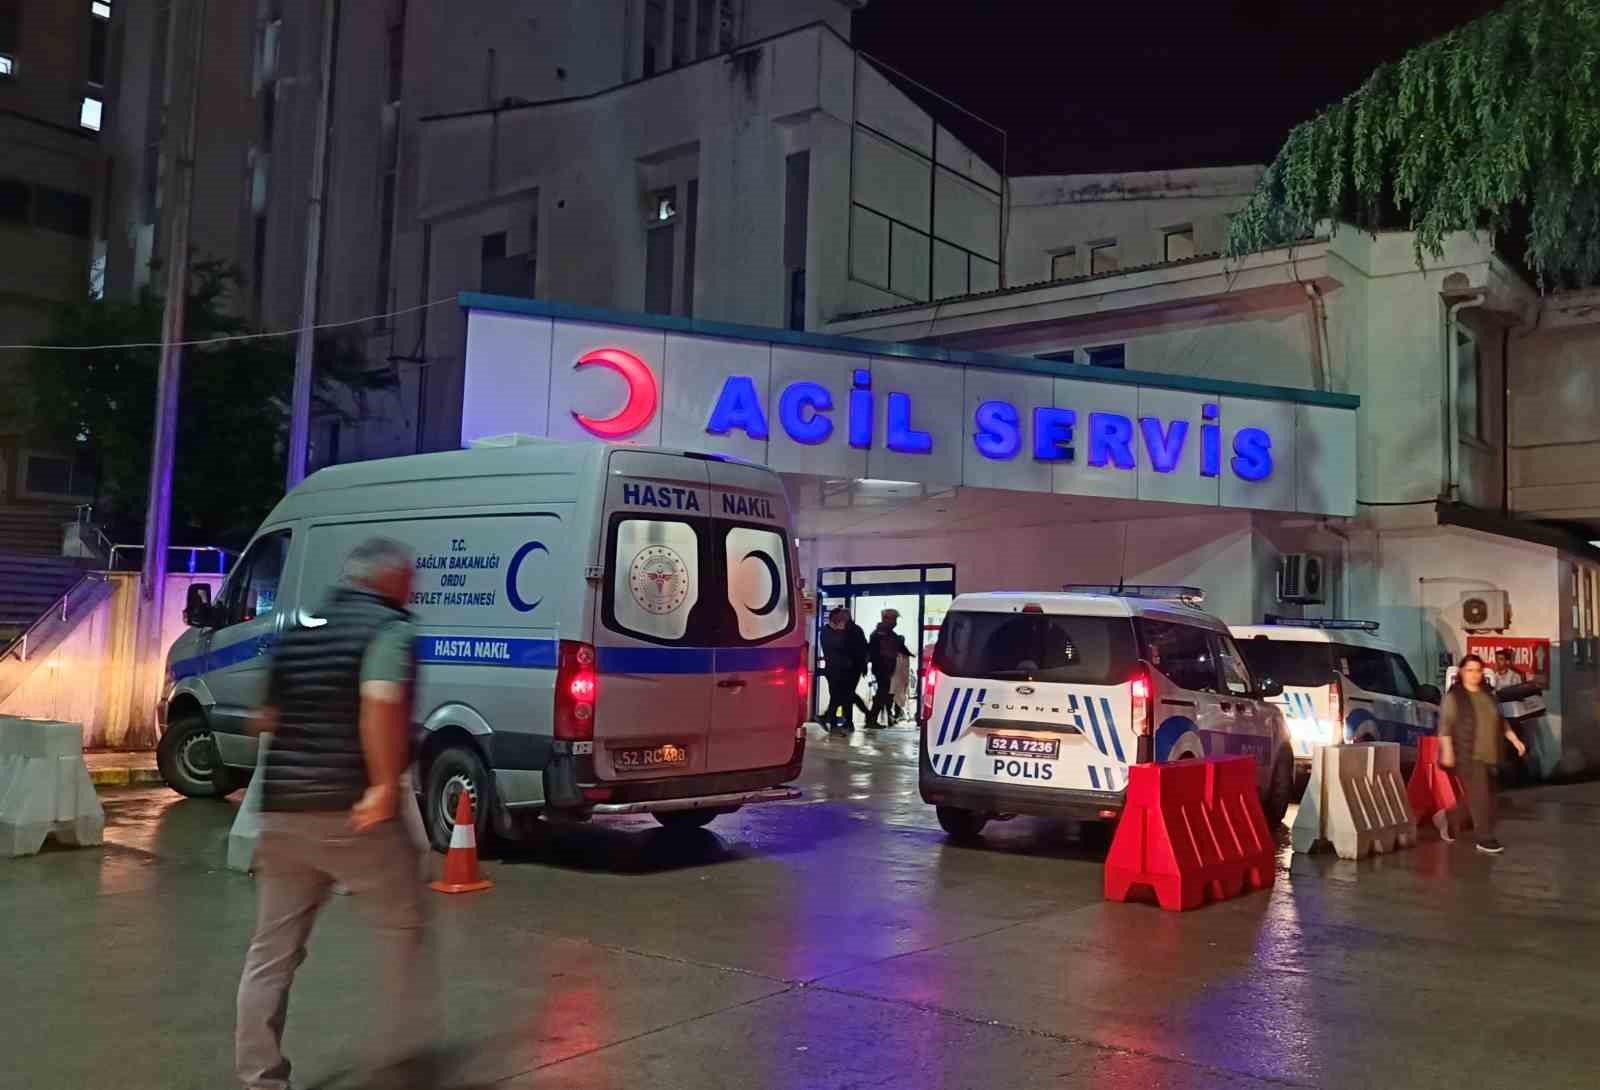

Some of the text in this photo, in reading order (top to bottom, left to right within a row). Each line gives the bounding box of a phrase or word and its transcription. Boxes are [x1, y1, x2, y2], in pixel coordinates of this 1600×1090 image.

[705, 368, 1273, 482] ACİL SERVİS
[623, 483, 700, 512] HASTA
[450, 539, 467, 552] T.C.
[415, 553, 500, 569] SAĞLIK BAKANLIĞI
[440, 574, 467, 587] ORDU
[443, 590, 496, 606] HASTANESİ
[434, 640, 472, 657] HASTA
[992, 739, 1053, 753] 52 A 7236
